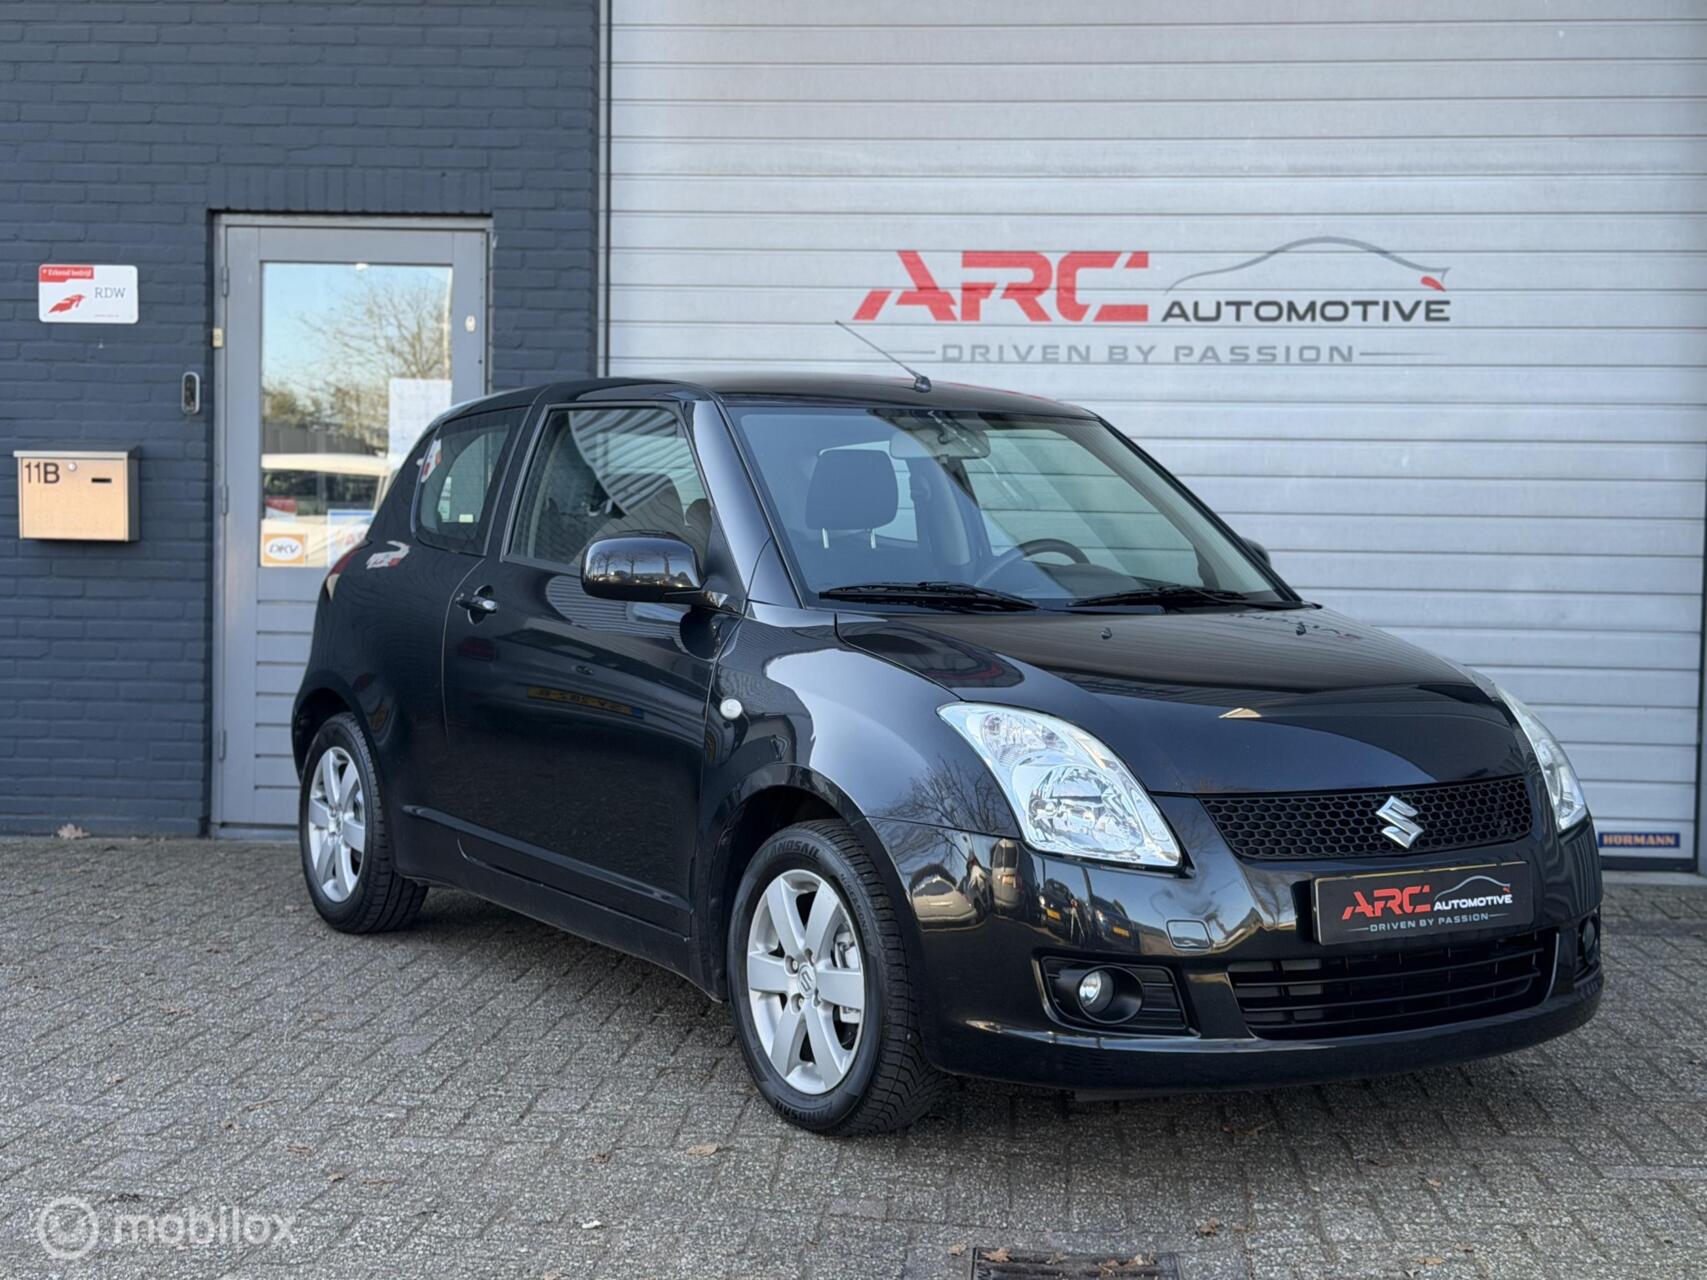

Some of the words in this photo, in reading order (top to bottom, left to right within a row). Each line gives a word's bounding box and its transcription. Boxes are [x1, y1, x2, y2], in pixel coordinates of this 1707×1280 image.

[94, 287, 126, 299] RDW
[852, 250, 1149, 322] ARC
[1161, 300, 1451, 322] AUTOMOTIVE
[942, 344, 1090, 363] DRIVEN
[1107, 344, 1156, 363] BY
[1174, 345, 1353, 363] PASSION
[24, 461, 60, 484] 11B
[1342, 884, 1431, 920] ARC
[1433, 894, 1513, 911] AUTOMOTIVE
[1370, 920, 1416, 932] DRIVEN
[1419, 917, 1434, 928] BY
[1438, 912, 1489, 925] PASSION
